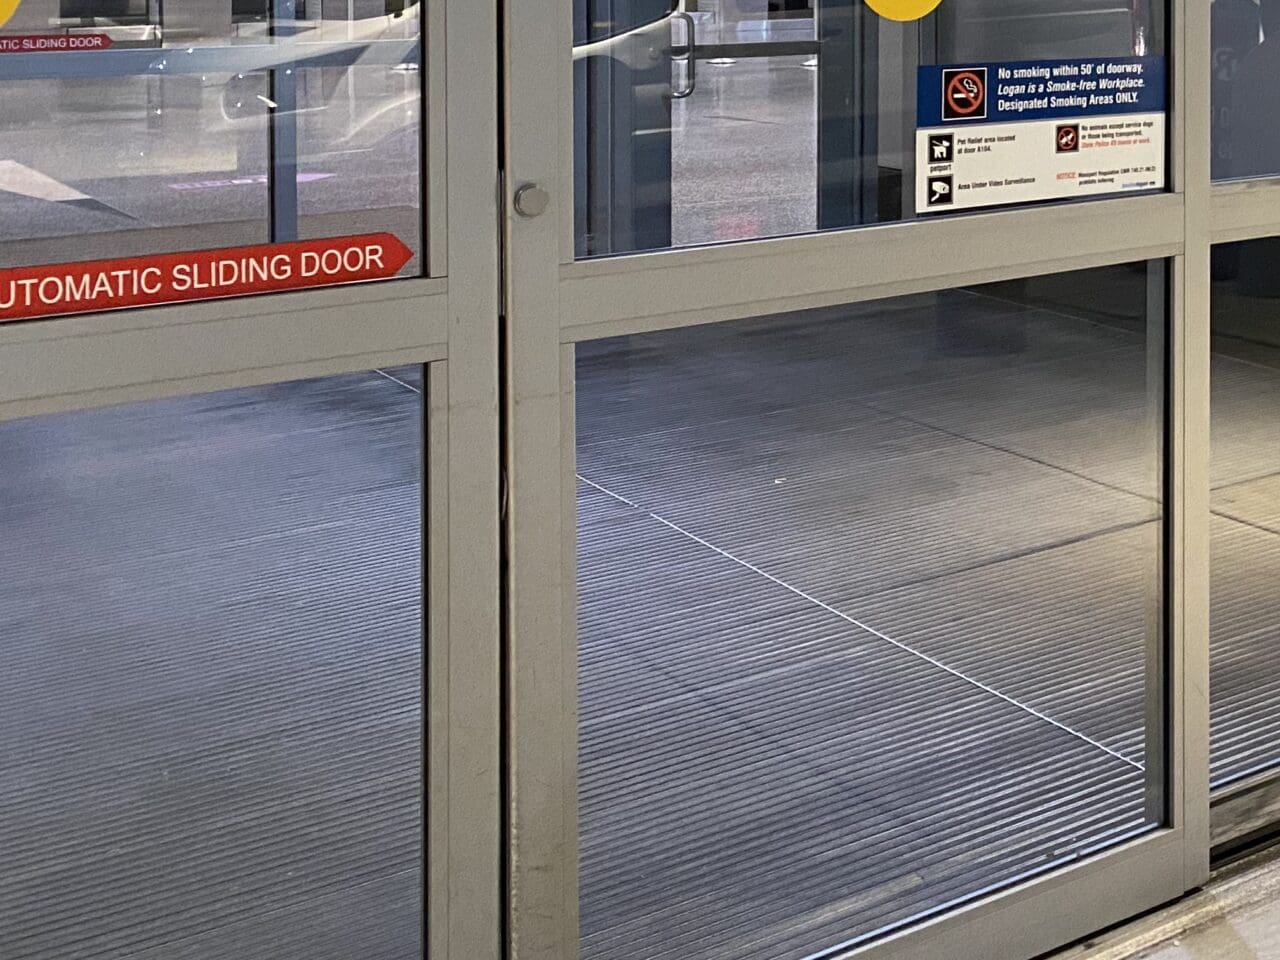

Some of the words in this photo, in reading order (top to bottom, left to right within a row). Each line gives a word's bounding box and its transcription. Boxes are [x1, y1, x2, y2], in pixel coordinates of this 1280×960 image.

[22, 38, 67, 49] SLIDING
[69, 36, 102, 47] DOOR
[998, 68, 1011, 79] No
[1013, 66, 1050, 79] smoking
[1052, 64, 1078, 76] within
[1097, 64, 1105, 74] of
[1107, 63, 1143, 74] doorway.
[998, 83, 1025, 97] Logan
[1028, 82, 1035, 93] is
[1047, 80, 1096, 92] Smoke-free
[1099, 78, 1145, 91] Workplace.
[998, 97, 1048, 111] Designated
[1050, 95, 1087, 108] Smoking
[1089, 94, 1113, 104] Areas
[1116, 92, 1138, 103] ONLY.
[0, 267, 162, 309] UTOMATIC
[171, 254, 292, 291] SLIDING
[300, 245, 385, 277] DOOR
